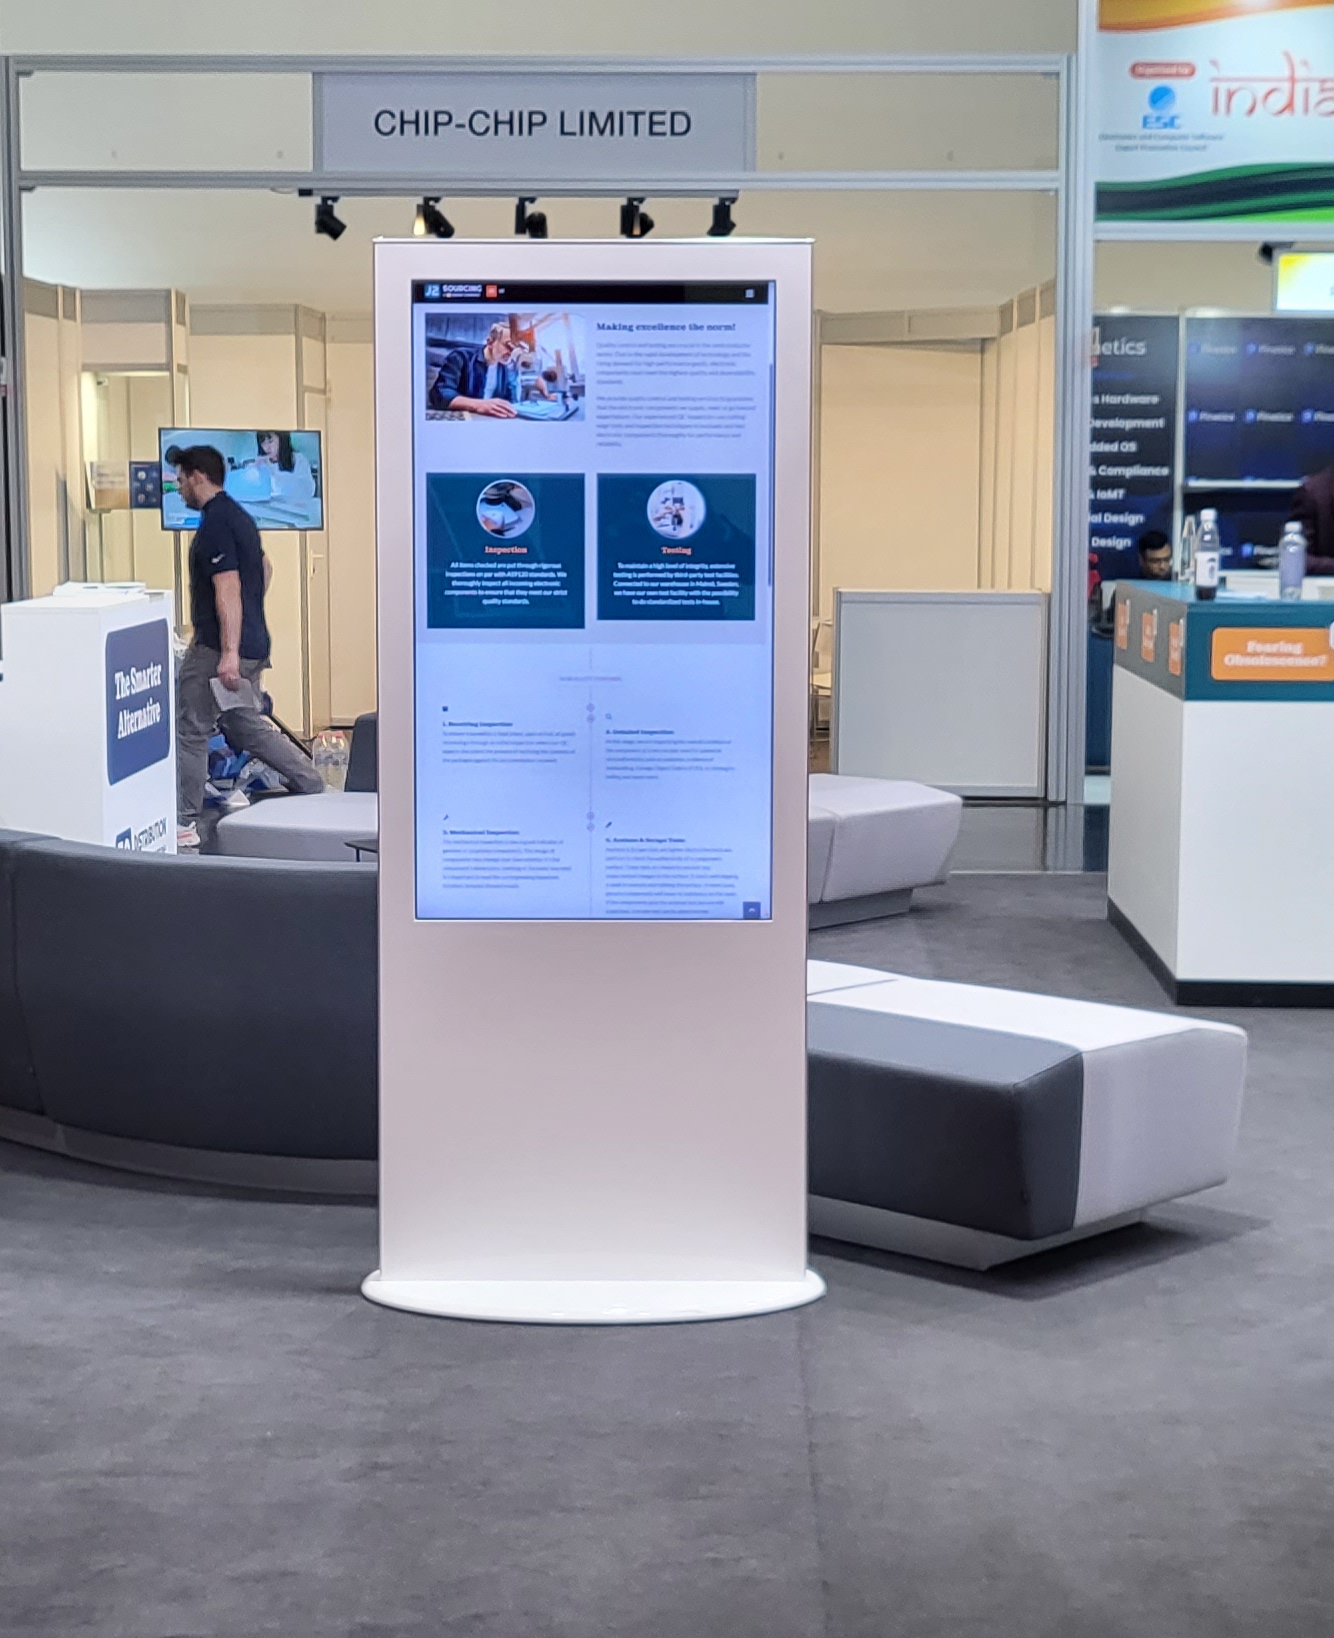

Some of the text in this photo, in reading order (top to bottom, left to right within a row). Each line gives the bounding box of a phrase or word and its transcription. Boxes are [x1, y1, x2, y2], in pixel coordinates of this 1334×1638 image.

[374, 109, 692, 137] CHIP-CHIP LIMITED
[596, 323, 736, 332] Making excellence the norm!
[1101, 393, 1159, 404] Hardware
[1098, 463, 1169, 478] Compliance
[1103, 512, 1144, 526] Design
[1091, 536, 1131, 549] Design
[114, 661, 162, 700] The Smarter
[117, 696, 161, 739] Alternative
